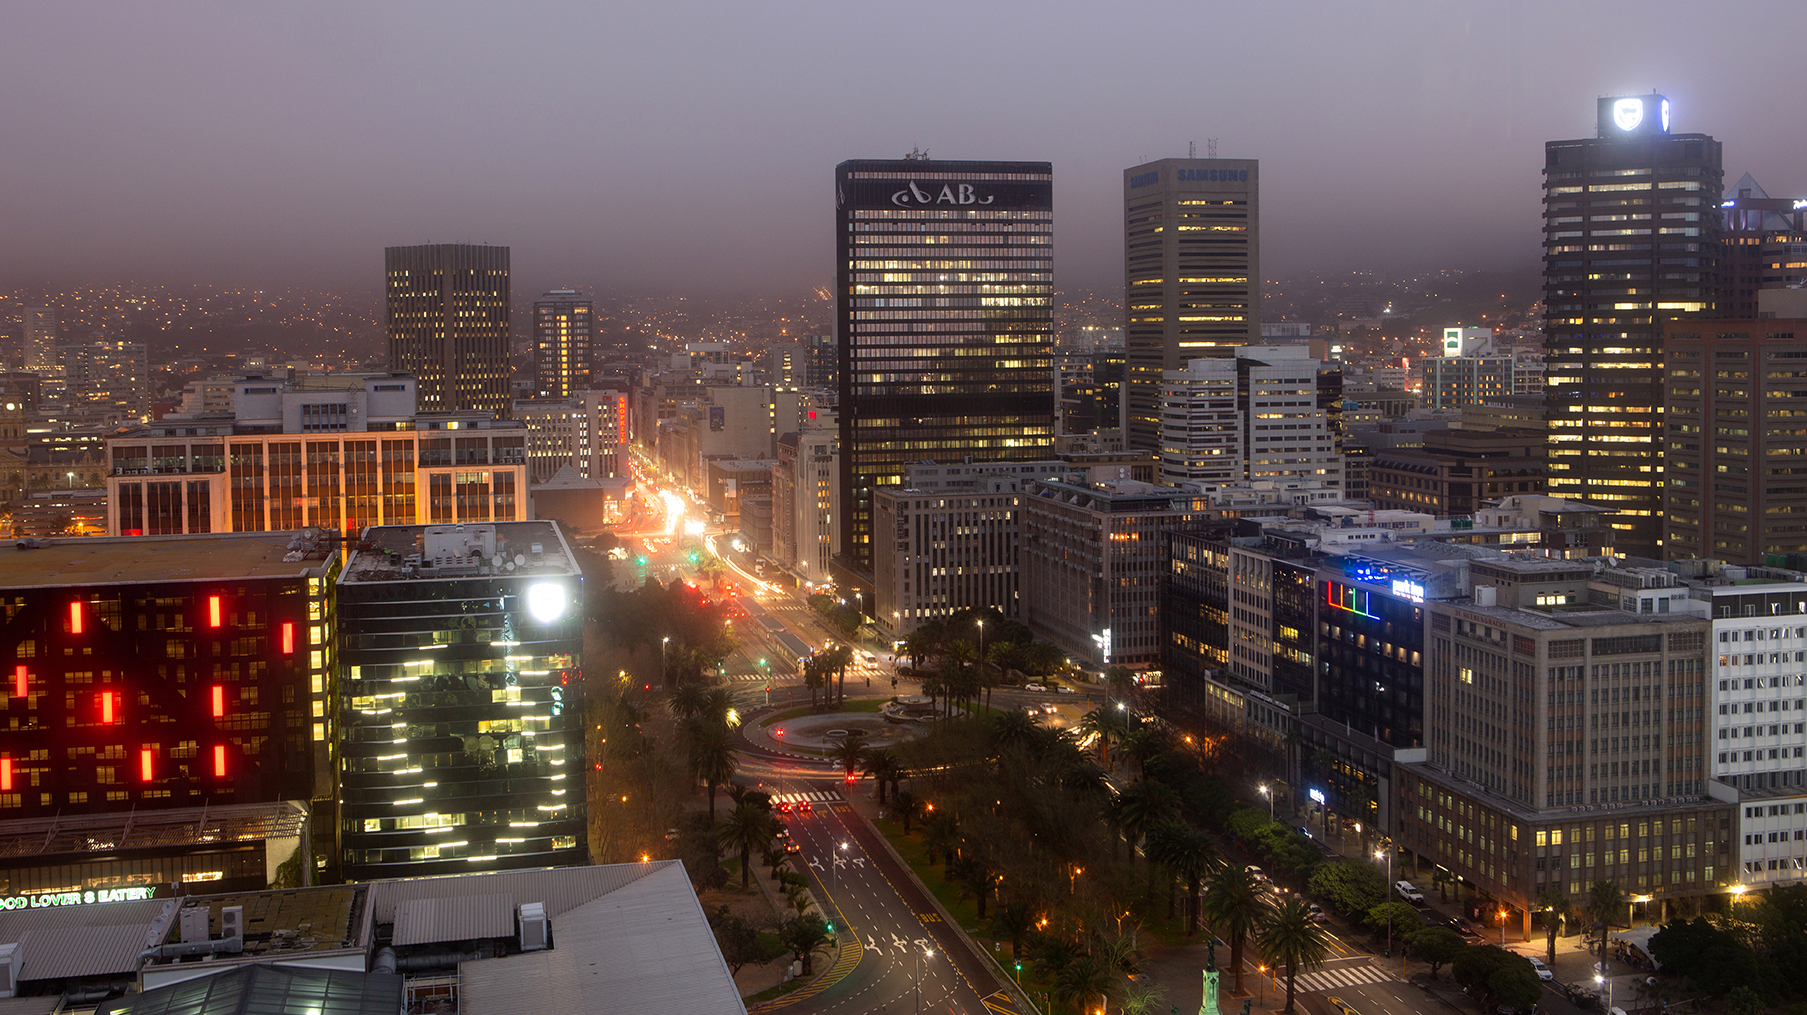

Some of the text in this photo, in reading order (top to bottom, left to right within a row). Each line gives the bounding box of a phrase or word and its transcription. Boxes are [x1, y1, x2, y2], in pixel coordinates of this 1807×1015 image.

[1178, 169, 1248, 182] SAMSUNG
[98, 887, 156, 903] EATERY
[920, 913, 942, 922] BUS
